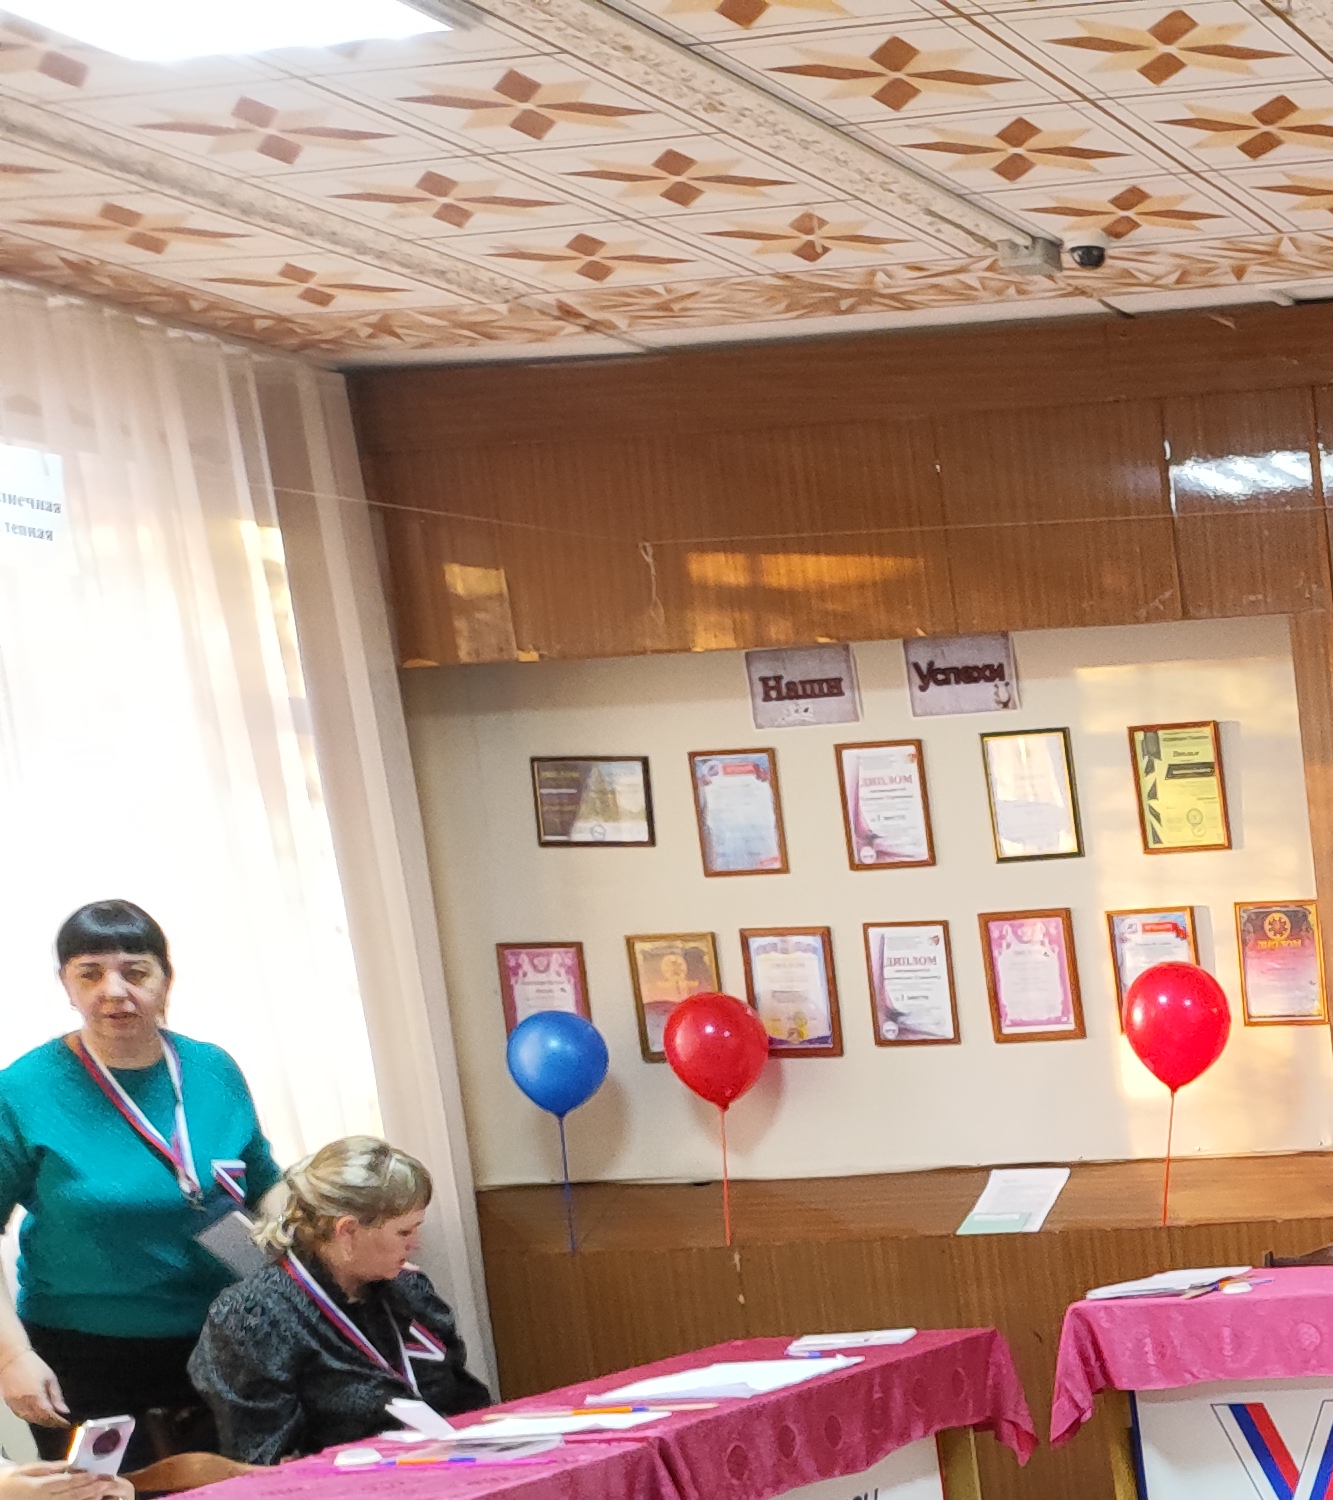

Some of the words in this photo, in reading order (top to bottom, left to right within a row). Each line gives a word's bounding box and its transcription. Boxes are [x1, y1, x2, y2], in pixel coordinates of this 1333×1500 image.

[0, 492, 61, 514] лнечная
[4, 521, 53, 541] тепная
[759, 675, 845, 702] Наши
[912, 660, 1006, 692] Успехи
